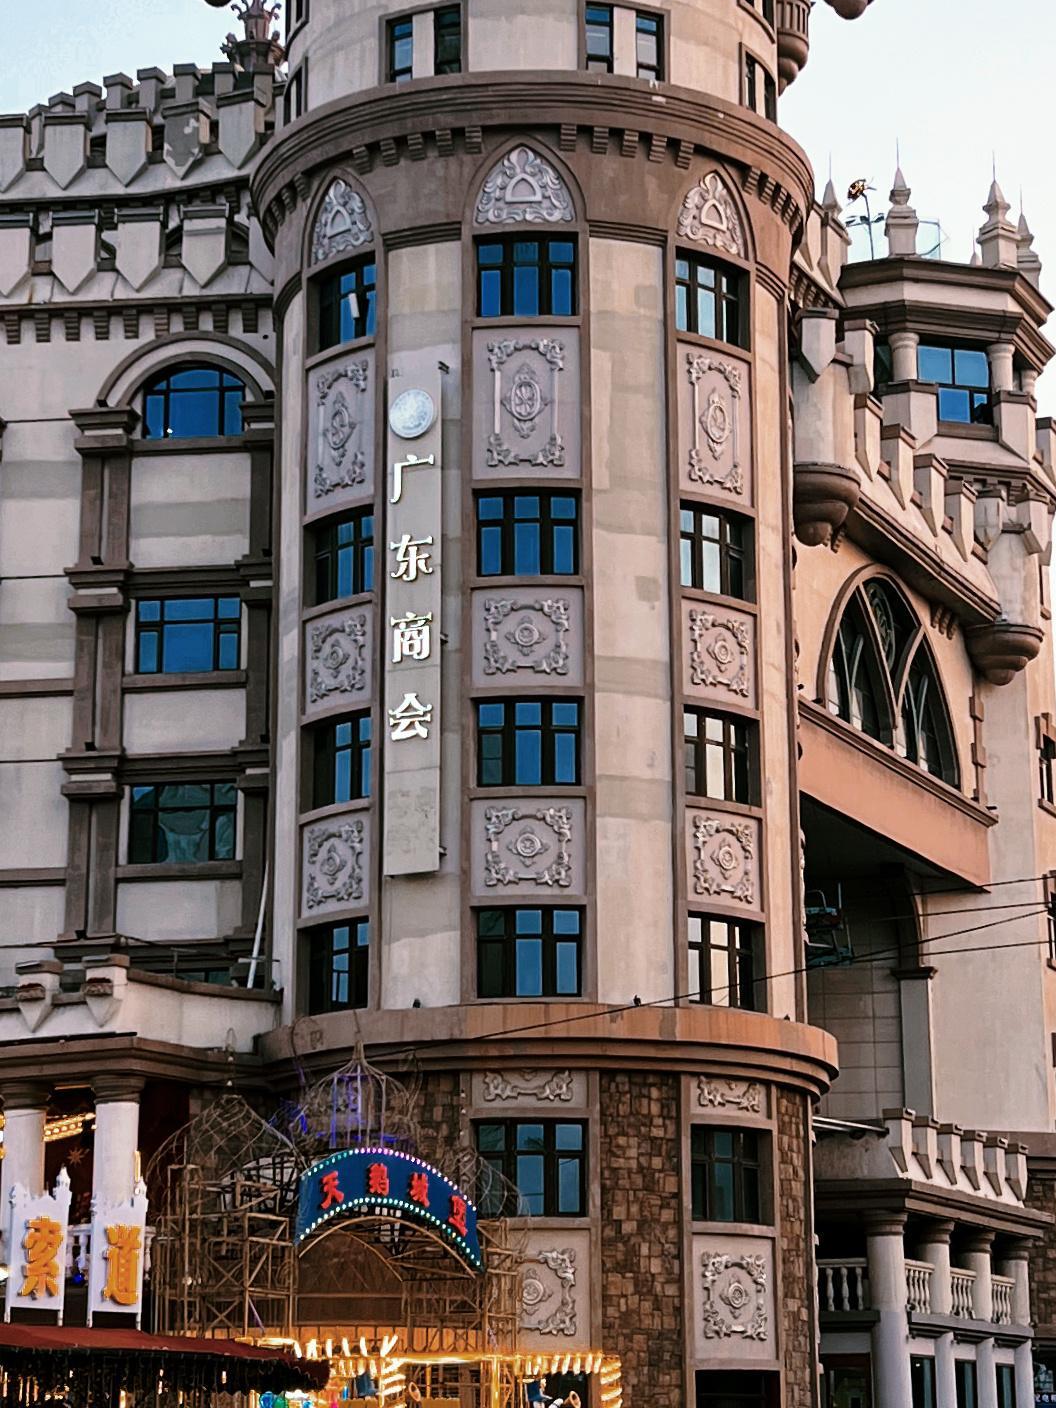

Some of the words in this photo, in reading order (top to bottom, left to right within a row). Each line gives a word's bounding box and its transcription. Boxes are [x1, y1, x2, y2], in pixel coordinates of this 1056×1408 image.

[389, 454, 435, 741] 广东商会
[21, 1216, 141, 1305] 索道
